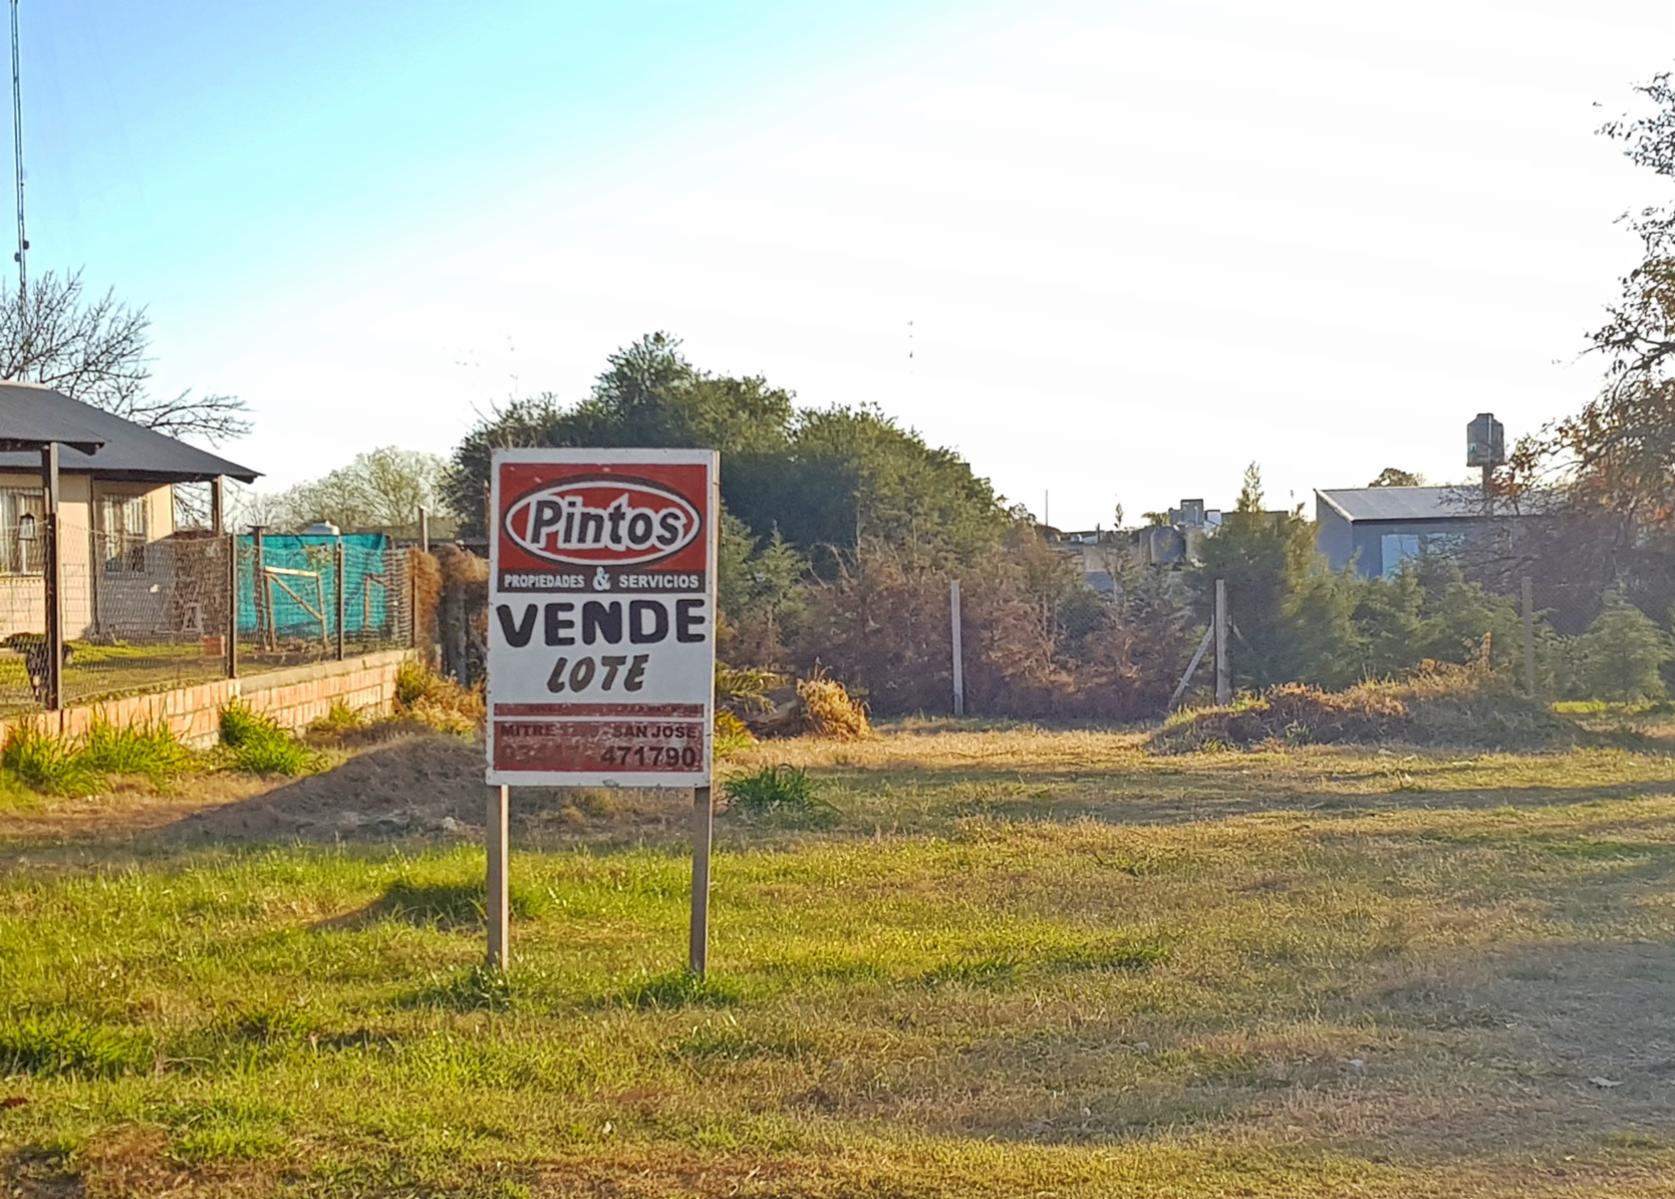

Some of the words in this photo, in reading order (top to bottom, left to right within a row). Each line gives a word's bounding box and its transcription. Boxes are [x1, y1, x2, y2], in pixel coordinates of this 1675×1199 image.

[529, 498, 684, 547] Pintos
[504, 574, 585, 588] PROPIEDADES
[592, 566, 611, 591] &
[619, 575, 699, 588] SERVICIOS
[496, 599, 706, 648] VENDE
[547, 654, 650, 693] LOTE
[501, 723, 557, 737] MITRE
[612, 725, 647, 738] SAN
[652, 725, 698, 738] JOSE
[600, 745, 696, 767] 471790
